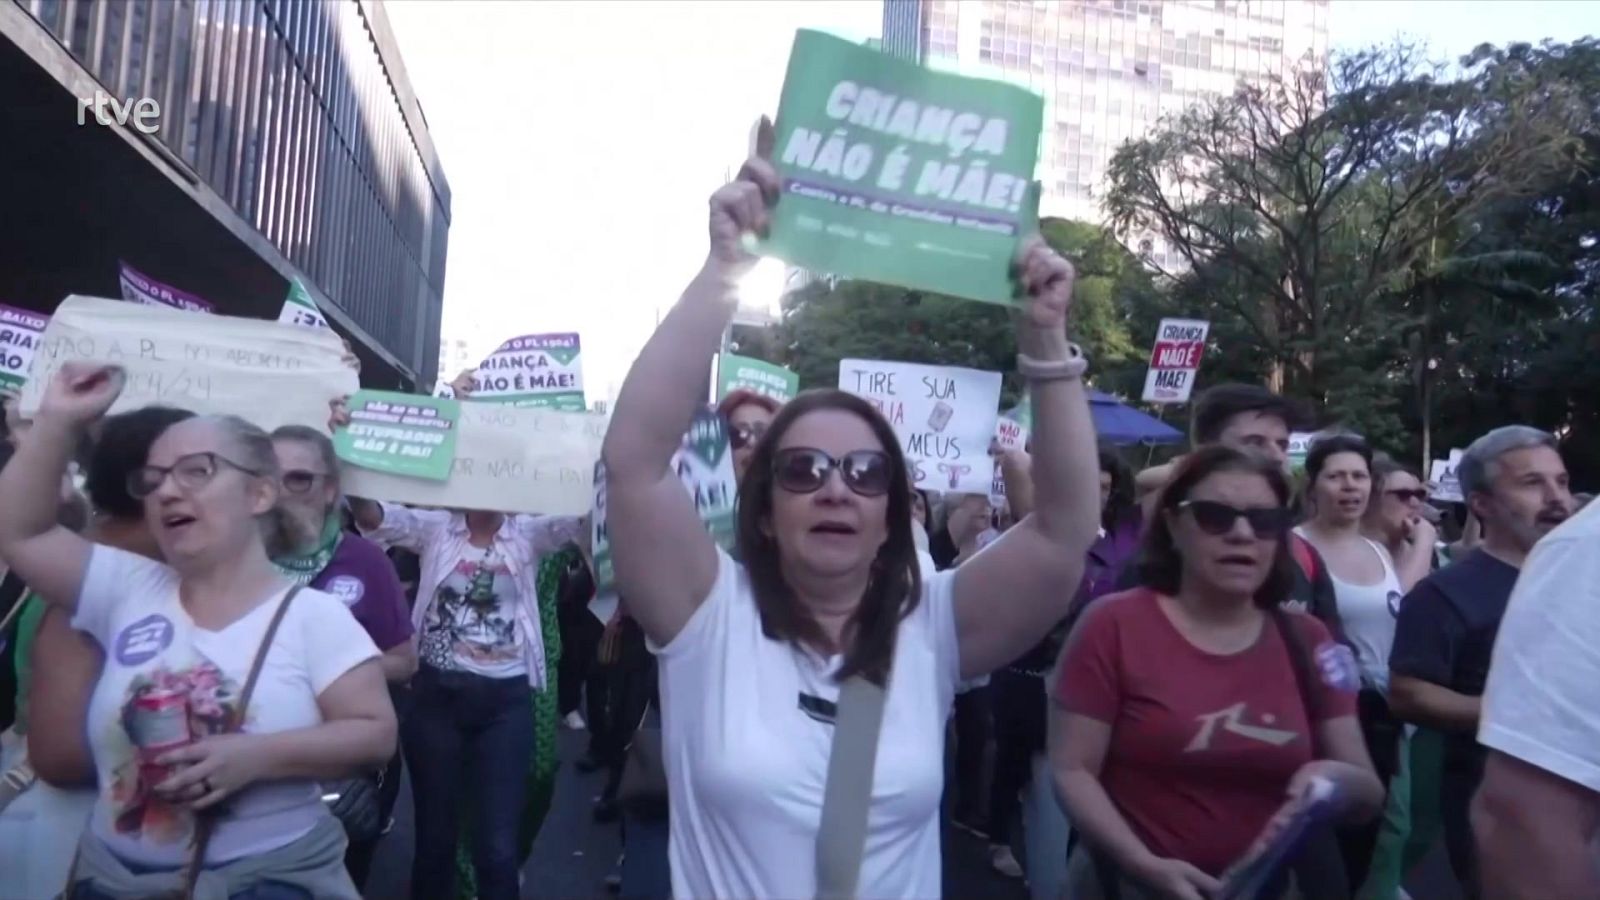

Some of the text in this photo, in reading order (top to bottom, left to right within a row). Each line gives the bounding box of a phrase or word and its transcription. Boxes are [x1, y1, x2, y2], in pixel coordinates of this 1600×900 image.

[826, 79, 1008, 157] CRIANÇA
[782, 127, 1027, 213] NÃO É MÃE!
[0, 310, 46, 329] BAIXO
[513, 373, 525, 391] É
[529, 371, 576, 389] MÃE!
[852, 370, 957, 400] TIRE SUA
[907, 432, 961, 460] MEUS
